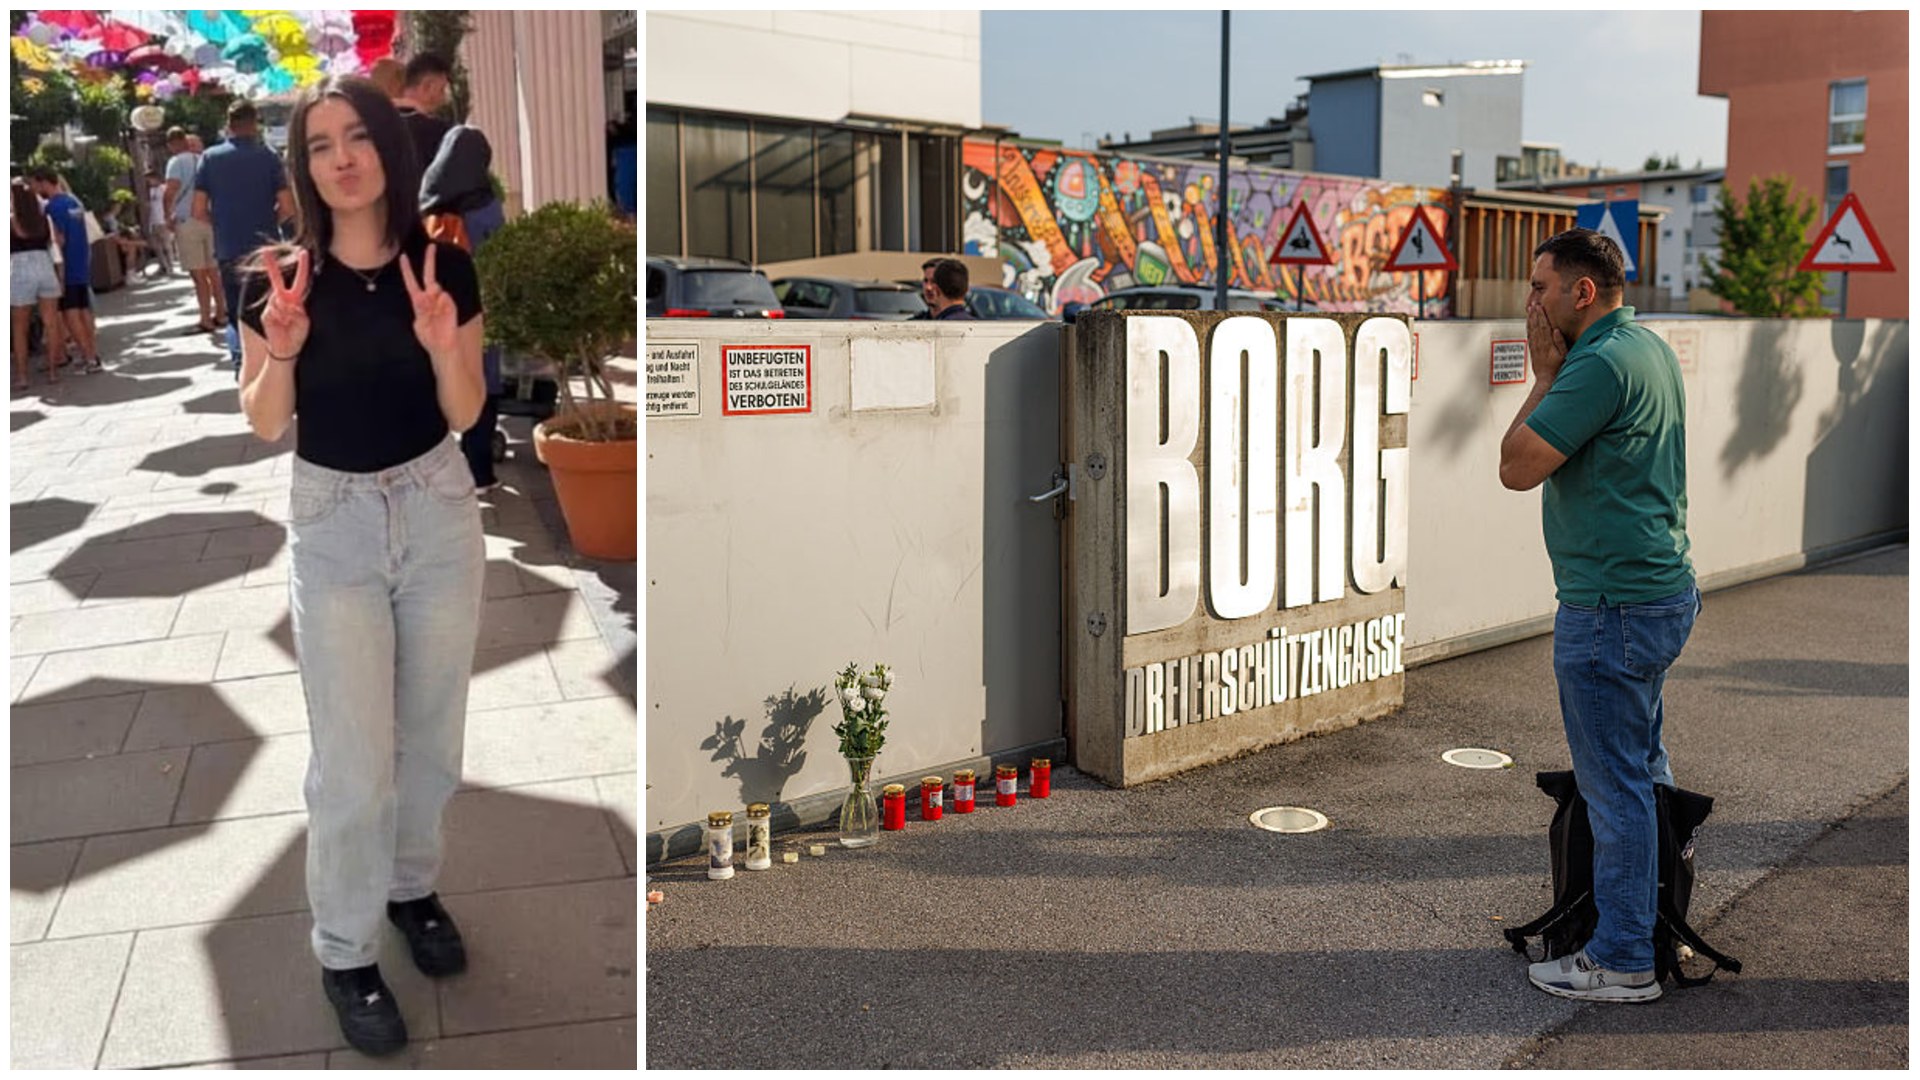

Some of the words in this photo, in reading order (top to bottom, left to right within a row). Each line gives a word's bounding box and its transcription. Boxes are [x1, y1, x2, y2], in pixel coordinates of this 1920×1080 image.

[666, 349, 695, 360] Ausfahrt
[729, 352, 804, 365] UNBEFUGTEN
[655, 362, 668, 372] und
[670, 362, 690, 372] Nacht
[729, 369, 741, 379] IST
[743, 369, 761, 379] DAS
[763, 368, 804, 378] BETRETEN
[729, 381, 743, 391] DES
[745, 379, 805, 391] SCHULGELÄNDES
[730, 393, 805, 409] VERBOTEN!
[1126, 315, 1410, 636] BORG
[1125, 612, 1407, 738] DREIERSCHÜTZENGASSE
